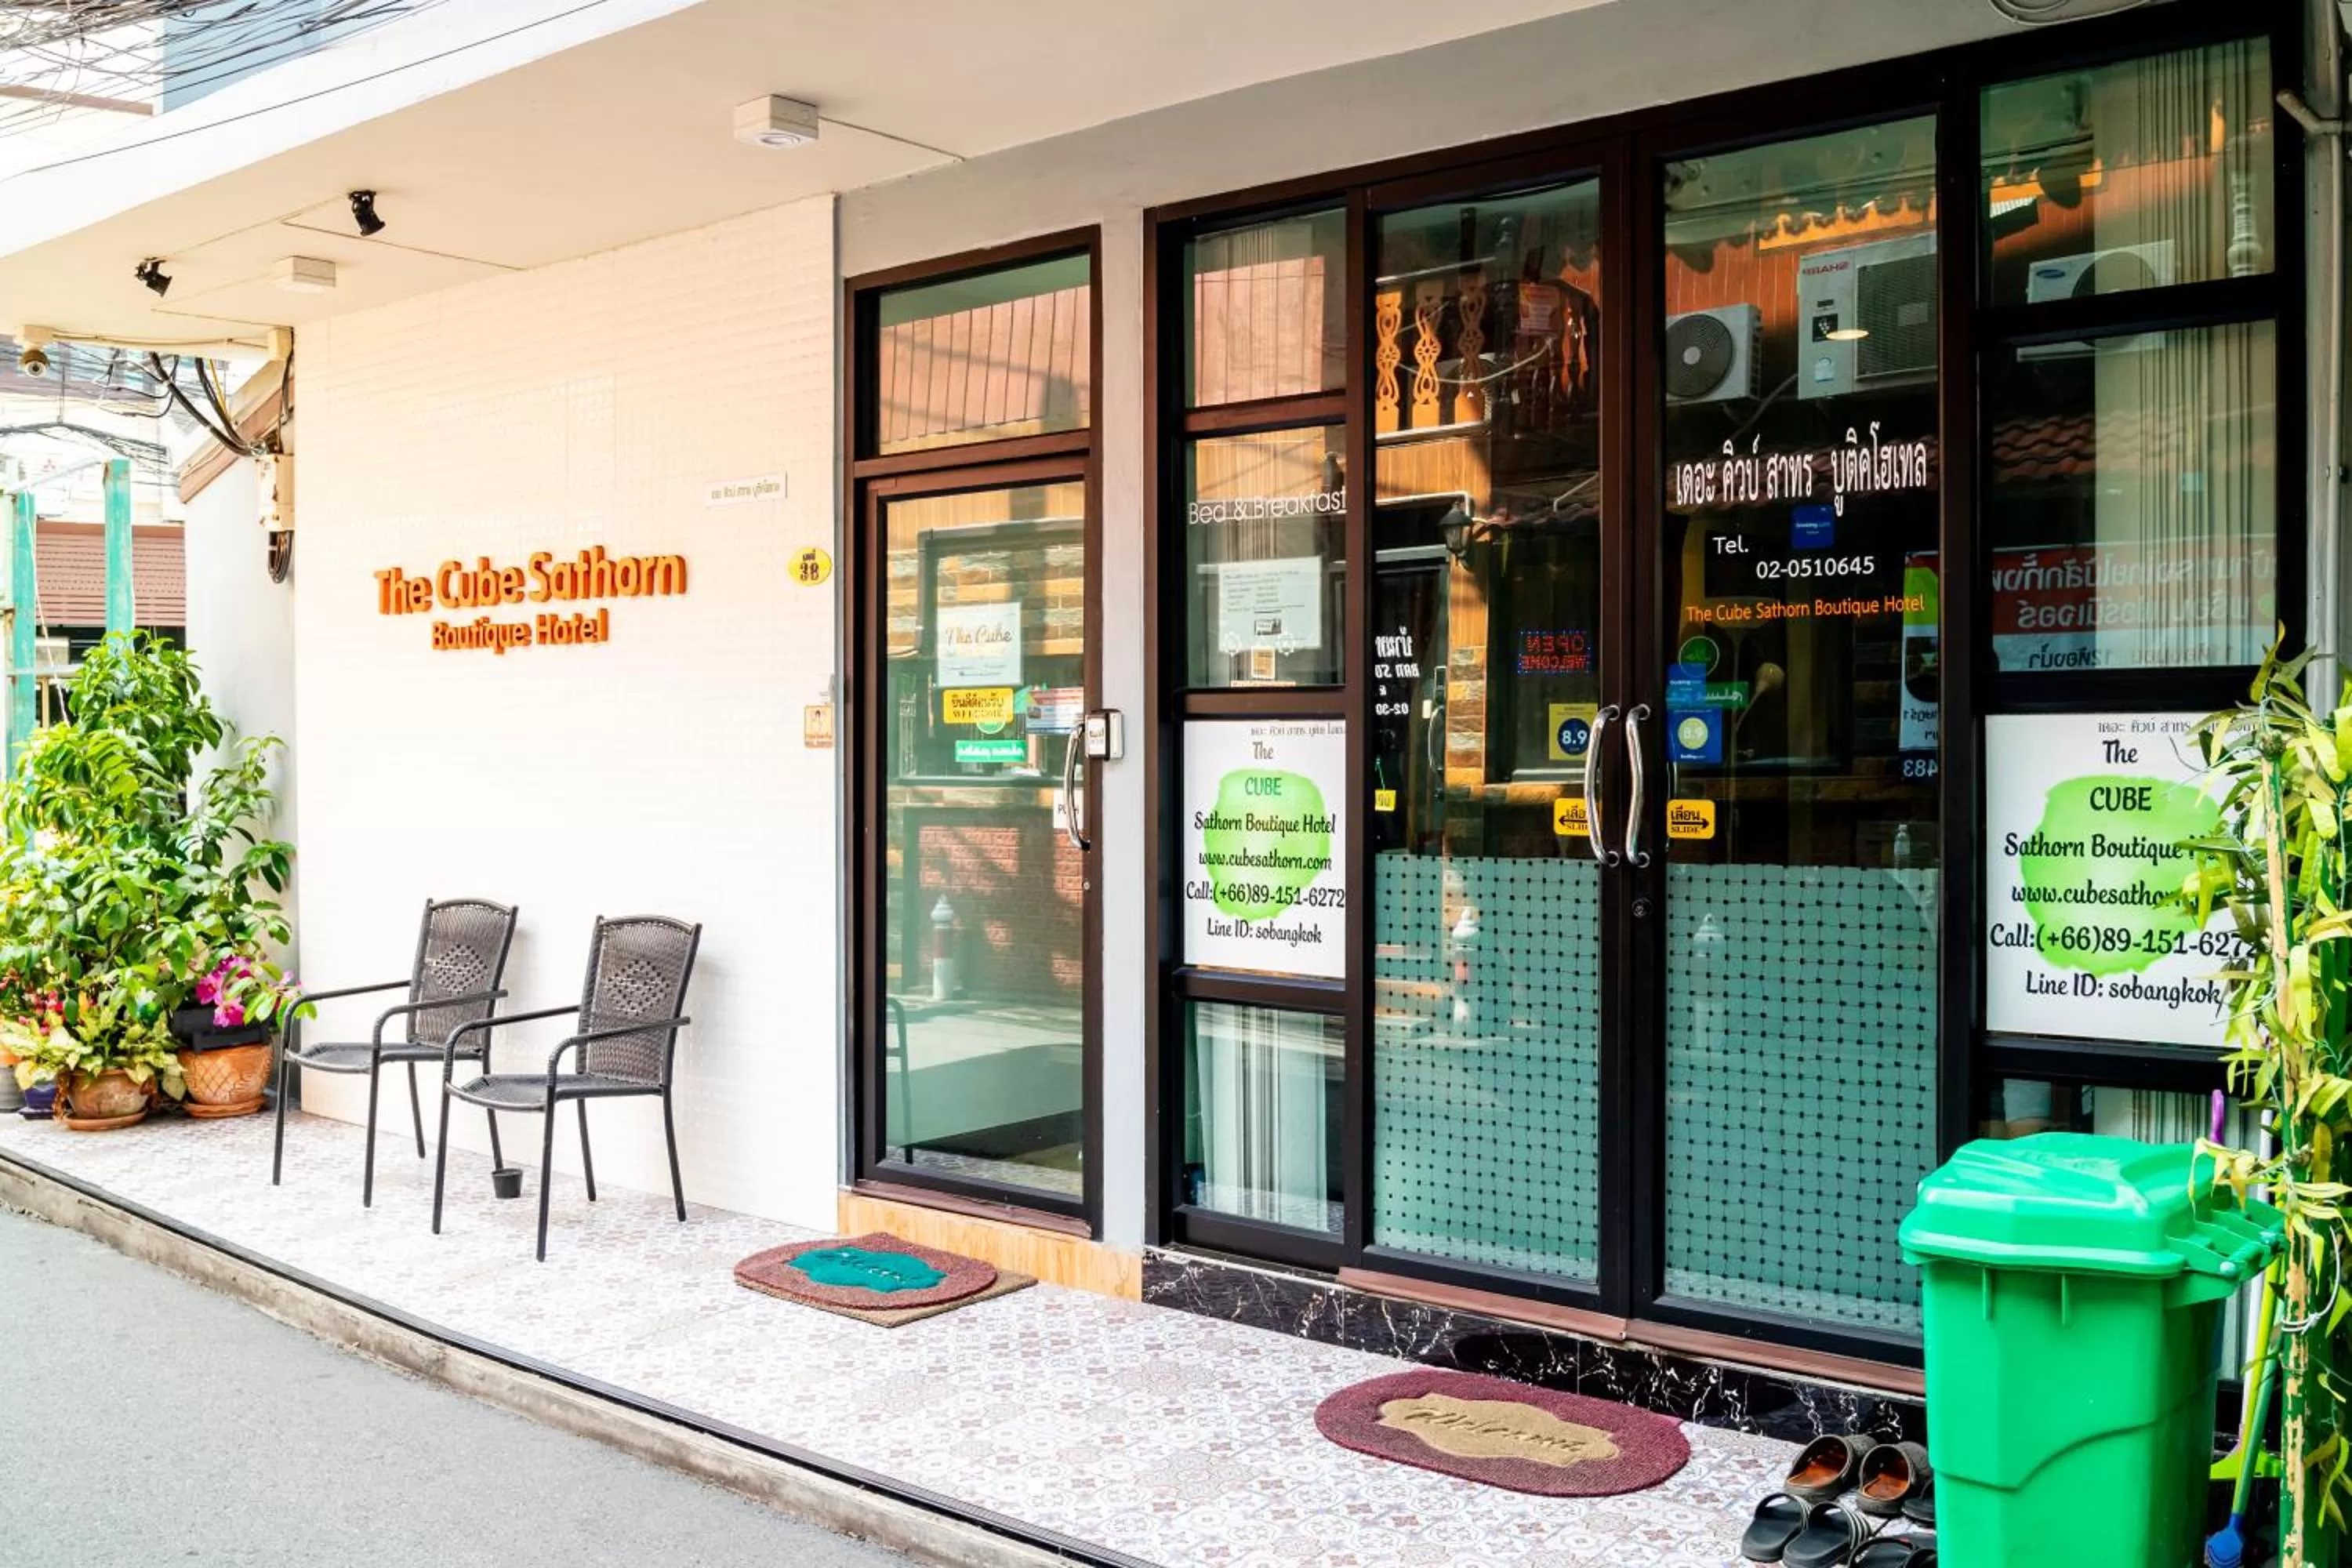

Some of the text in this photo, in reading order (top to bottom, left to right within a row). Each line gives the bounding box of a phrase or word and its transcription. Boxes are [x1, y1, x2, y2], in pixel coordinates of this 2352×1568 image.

[1676, 461, 1716, 506] เดอะ
[1722, 434, 1760, 503] คิวบ์
[1766, 451, 1813, 500] สาทร
[1189, 485, 1347, 524] Bed & Breakfast
[1712, 535, 1749, 555] Tel.
[374, 544, 688, 615] The Cube Sathorn
[799, 561, 820, 583] 38
[1756, 556, 1875, 579] 02-0510645
[1686, 595, 1925, 622] The Cube Sathorn Boutique Hotel
[432, 608, 609, 655] Boutique Hotel
[1562, 729, 1588, 746] 8.9
[1252, 742, 1274, 760] The
[2102, 740, 2139, 764] The
[1244, 777, 1283, 796] CUBE
[2089, 786, 2152, 811] CUBE
[1566, 803, 1587, 818] เลื่อ
[1671, 804, 1700, 820] เลื่อน
[1194, 811, 1335, 837] Sathorn Boutique Hotel
[1671, 826, 1700, 834] SLIDE
[1199, 848, 1332, 870] www.cubesathorn.com
[2005, 833, 2085, 858] Sathorn
[2091, 833, 2182, 866] Boutique
[2012, 880, 2195, 908] www.cubesatho
[1207, 917, 1322, 947] Line ID: sobangkok
[2026, 970, 2220, 1010] Line ID: sobangkok
